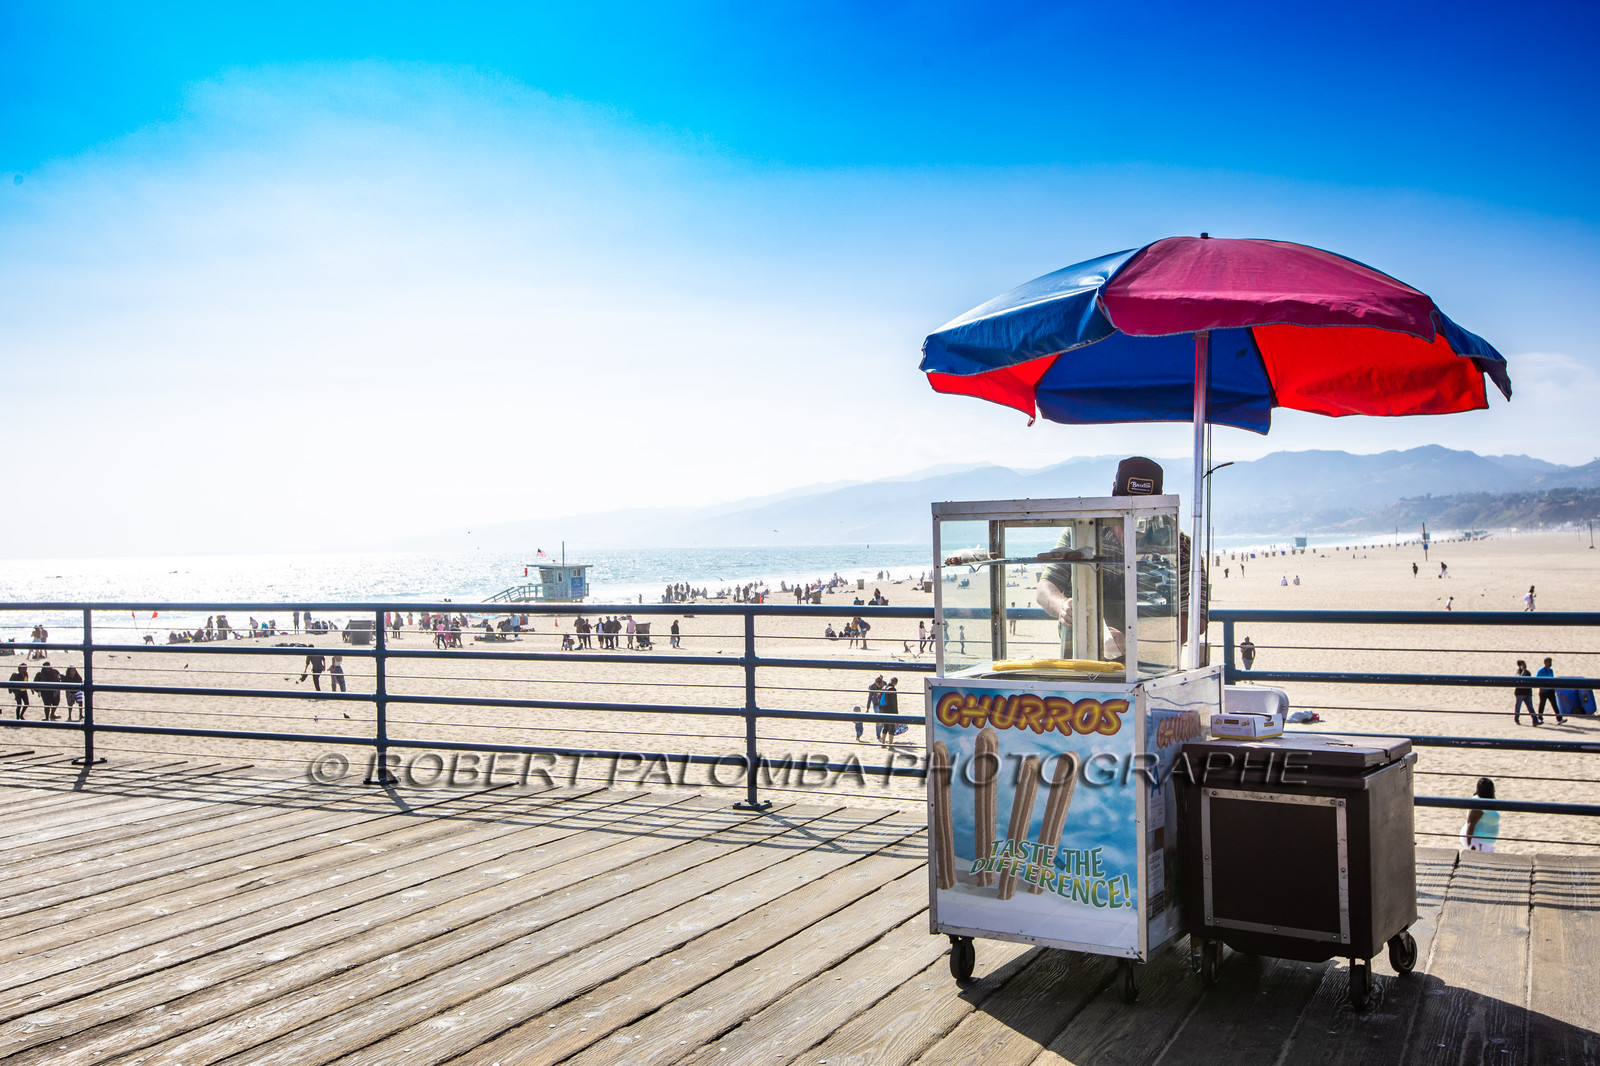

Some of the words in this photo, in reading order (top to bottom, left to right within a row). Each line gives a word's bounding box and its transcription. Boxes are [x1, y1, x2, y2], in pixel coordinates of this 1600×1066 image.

[936, 691, 1130, 736] CHURROS
[1157, 711, 1201, 749] CHURR
[990, 839, 1056, 867] TASTE
[1062, 847, 1106, 878] THE
[969, 856, 1132, 909] DIFFERENCE!
